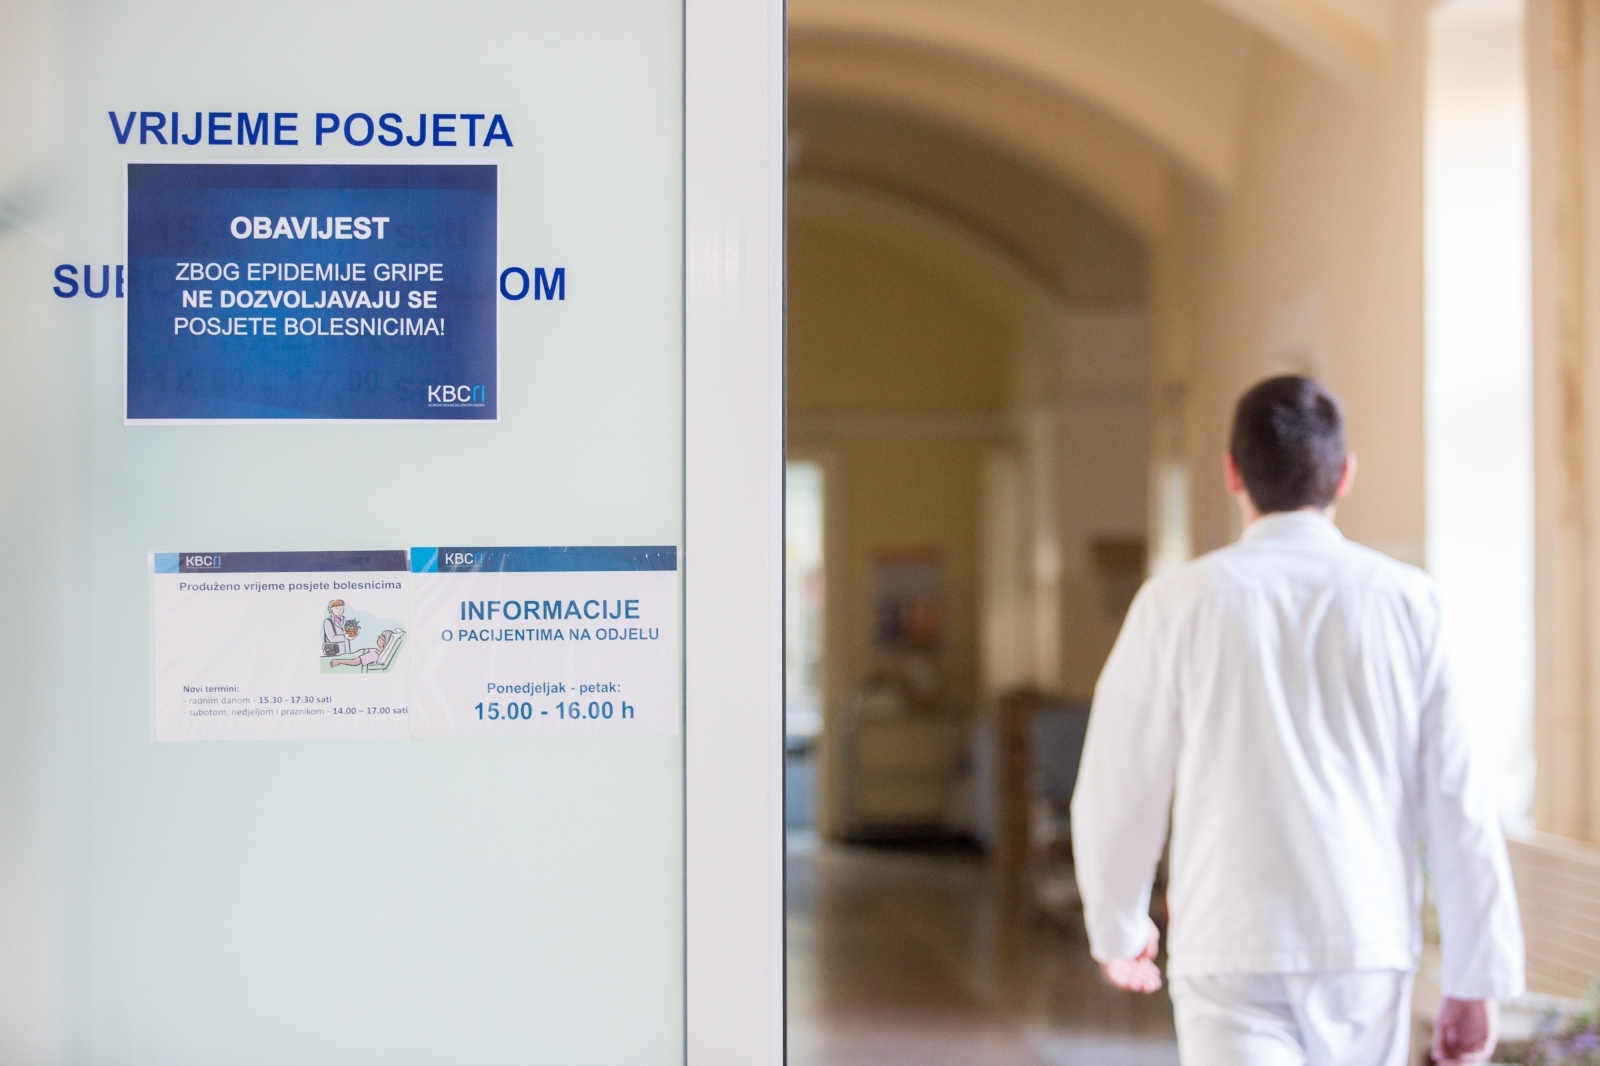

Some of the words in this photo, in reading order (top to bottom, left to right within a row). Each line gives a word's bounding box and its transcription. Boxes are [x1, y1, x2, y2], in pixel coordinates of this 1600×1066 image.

[108, 111, 299, 146] VRIJEME
[315, 112, 514, 148] POSJETA
[230, 215, 390, 240] OBAVIJEST
[53, 263, 124, 299] SU
[175, 262, 240, 281] ZBOG
[247, 262, 367, 282] EPIDEMIJE
[373, 262, 444, 282] GRIPE
[182, 289, 213, 308] NE
[220, 289, 400, 309] DOZVOLJAVAJU
[407, 290, 438, 309] SE
[174, 316, 277, 336] POSJETE
[284, 317, 445, 336] BOLESNICIMA!
[179, 582, 241, 591] Produženo
[243, 581, 285, 592] vrijeme
[288, 581, 330, 592] posjete
[333, 580, 402, 590] bolesnicima
[460, 599, 640, 621] INFORMACIJE
[441, 629, 454, 642] O
[458, 628, 565, 642] PACIJENTIMA
[569, 628, 592, 641] NA
[595, 627, 659, 641] ODJELU
[183, 685, 203, 693] Novi
[205, 684, 240, 693] termini:
[487, 681, 567, 696] Ponedjeljak
[579, 681, 621, 695] petak:
[188, 697, 219, 705] radnim
[220, 696, 251, 705] danom
[258, 696, 283, 704] 15.30
[290, 695, 315, 704] 17.30
[316, 695, 332, 704] sati
[188, 708, 229, 717] subotom,
[231, 708, 274, 717] nedjeljom
[280, 707, 325, 717] praznikom
[332, 707, 357, 715] 14.00
[366, 706, 391, 715] 17.00
[392, 706, 409, 715] sati
[474, 701, 533, 721] 15.00
[555, 700, 614, 720] 16.00
[621, 700, 635, 719] h
